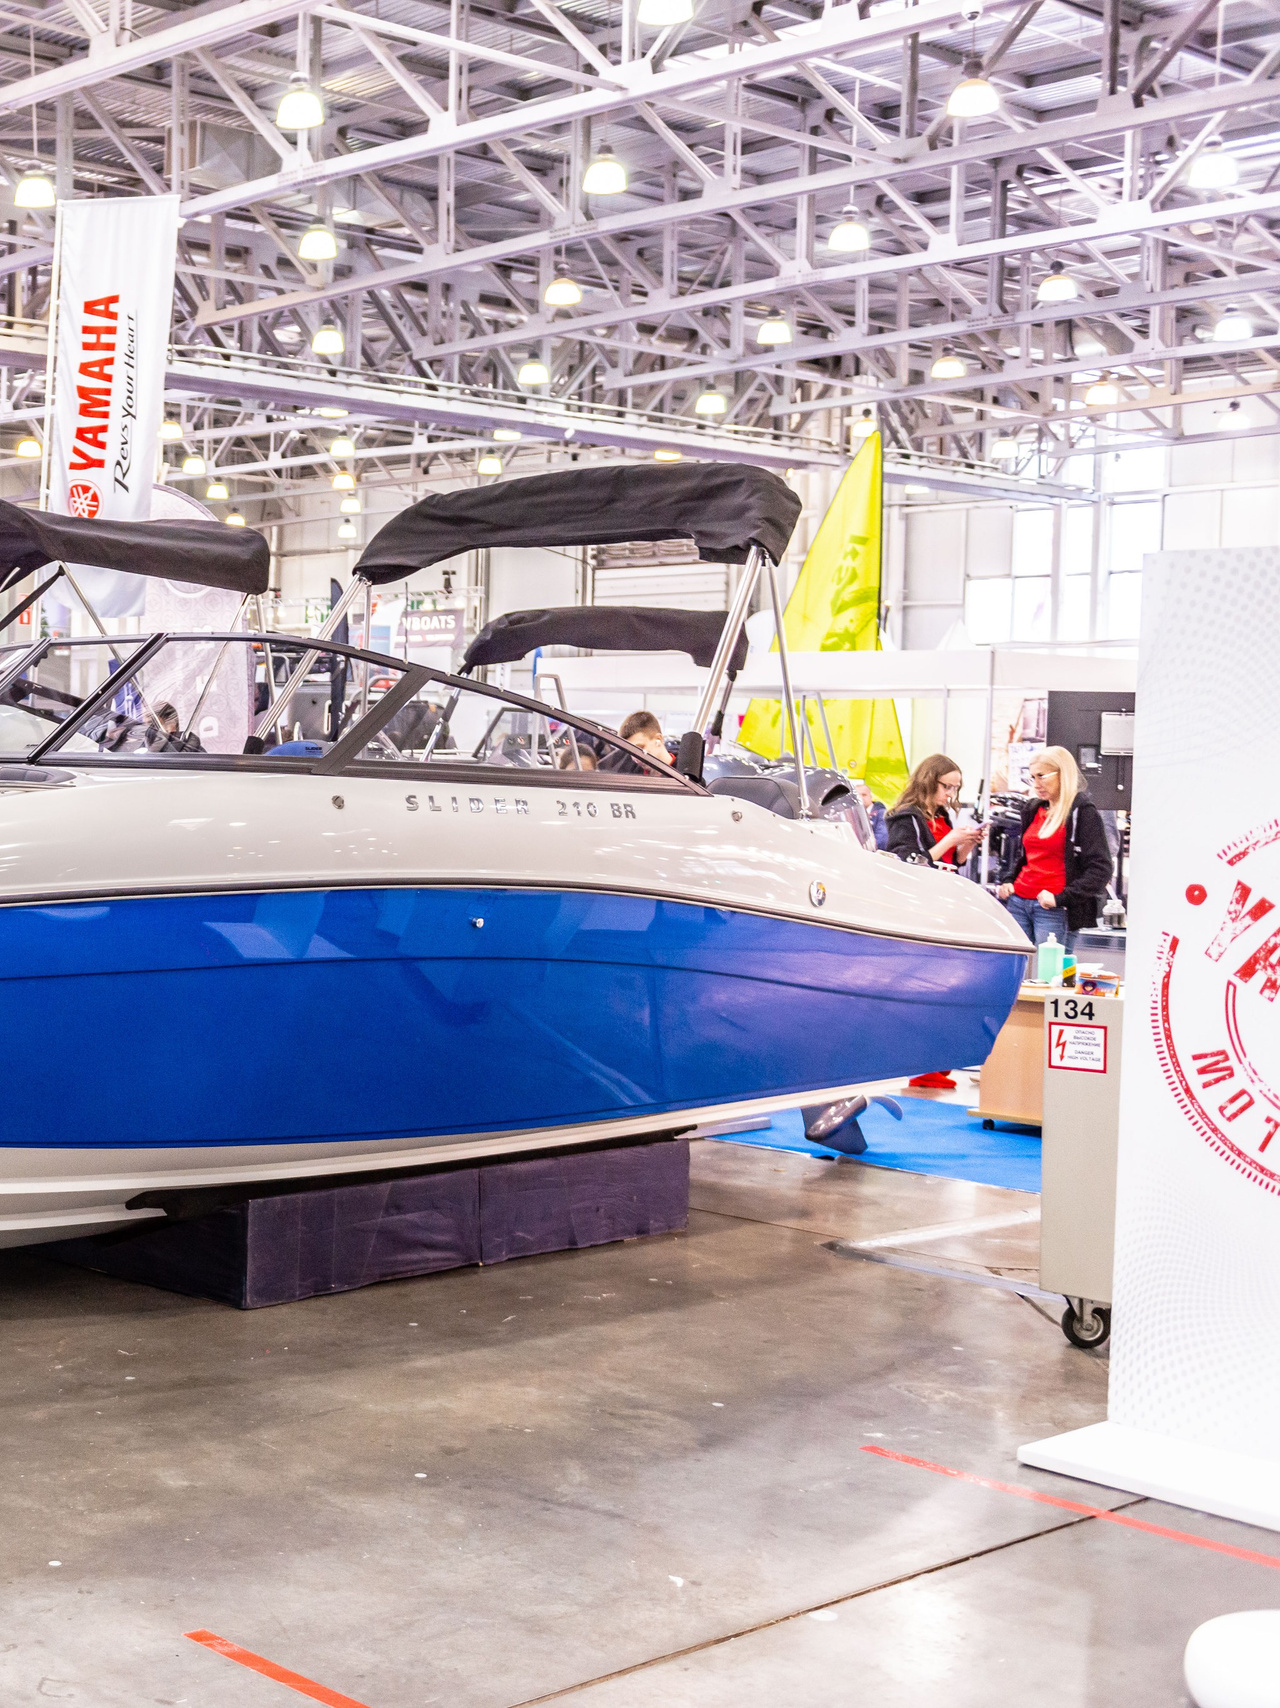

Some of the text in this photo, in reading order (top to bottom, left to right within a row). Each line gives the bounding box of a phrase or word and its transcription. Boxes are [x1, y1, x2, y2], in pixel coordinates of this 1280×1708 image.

[68, 294, 120, 470] YAMAHA
[114, 312, 137, 494] Revs Your Heart
[405, 794, 637, 819] SLIDER 210 BR
[1050, 998, 1095, 1021] 134
